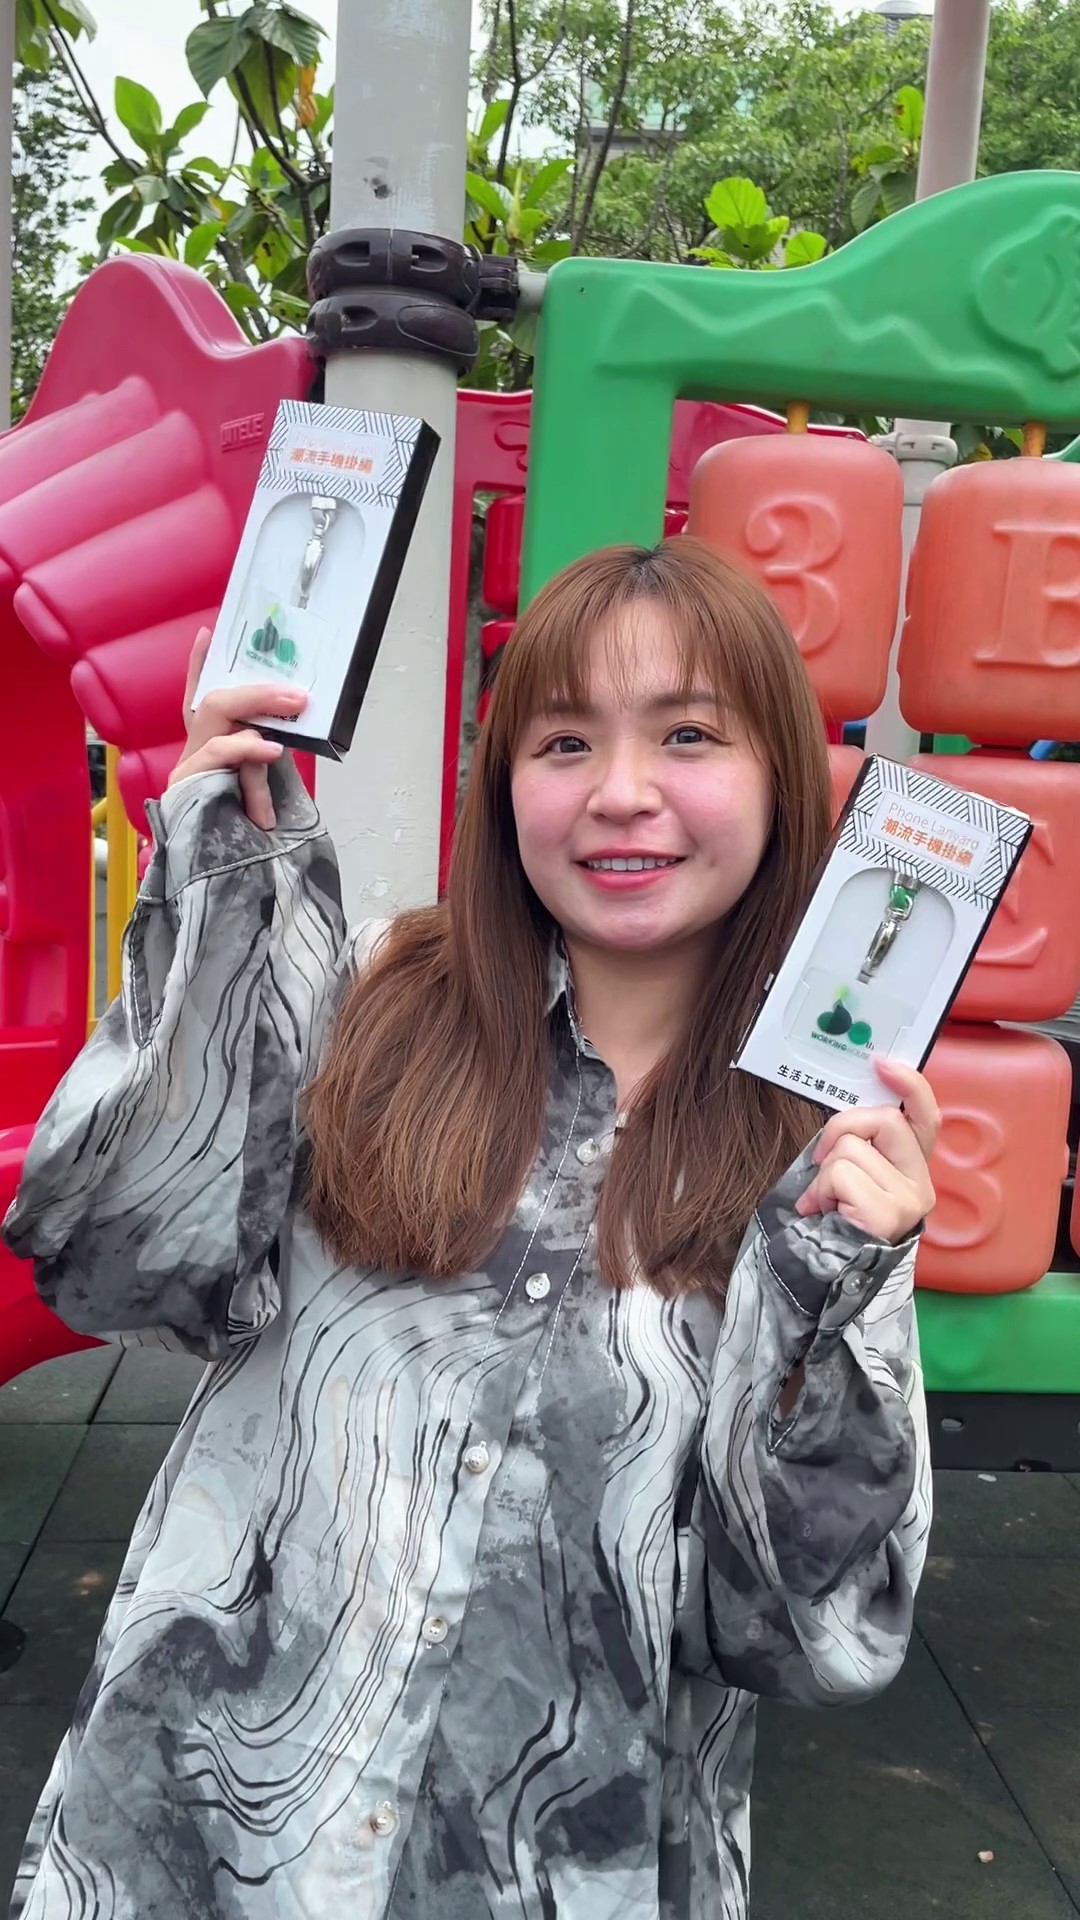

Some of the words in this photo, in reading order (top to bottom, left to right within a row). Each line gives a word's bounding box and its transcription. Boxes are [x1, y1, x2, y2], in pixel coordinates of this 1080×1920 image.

[745, 494, 843, 661] 3
[881, 817, 973, 866] 潮流手機掛繩
[889, 803, 928, 827] Phone
[931, 819, 980, 849] Lanyard
[777, 1065, 825, 1091] 生活工場
[826, 1084, 860, 1106] 限定版
